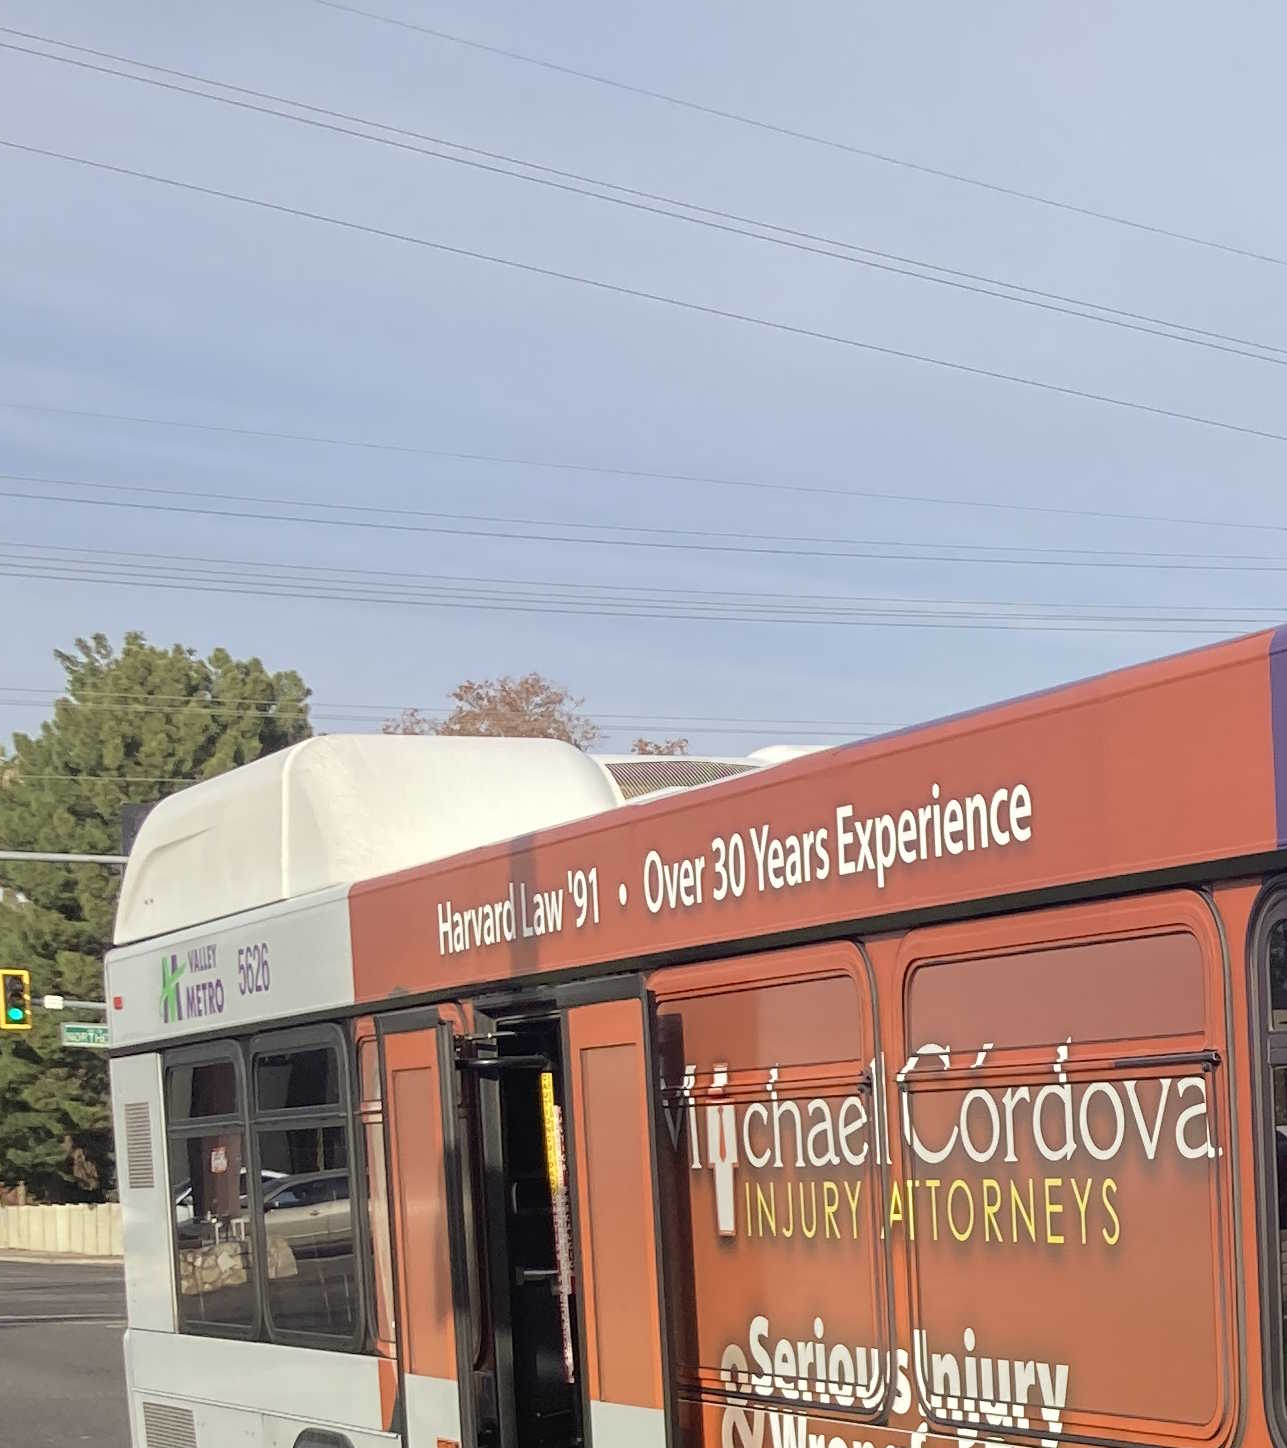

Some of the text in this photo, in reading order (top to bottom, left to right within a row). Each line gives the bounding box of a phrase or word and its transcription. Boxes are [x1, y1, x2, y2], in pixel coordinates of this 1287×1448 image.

[437, 782, 1034, 955] Harvard Law '91 Over 30 Years Experience
[187, 943, 217, 974] VALLEY
[238, 942, 270, 996] 5626
[186, 977, 225, 1019] METRO
[744, 1176, 1122, 1247] INJURY ATTORNEYS
[749, 1315, 910, 1416] Serious
